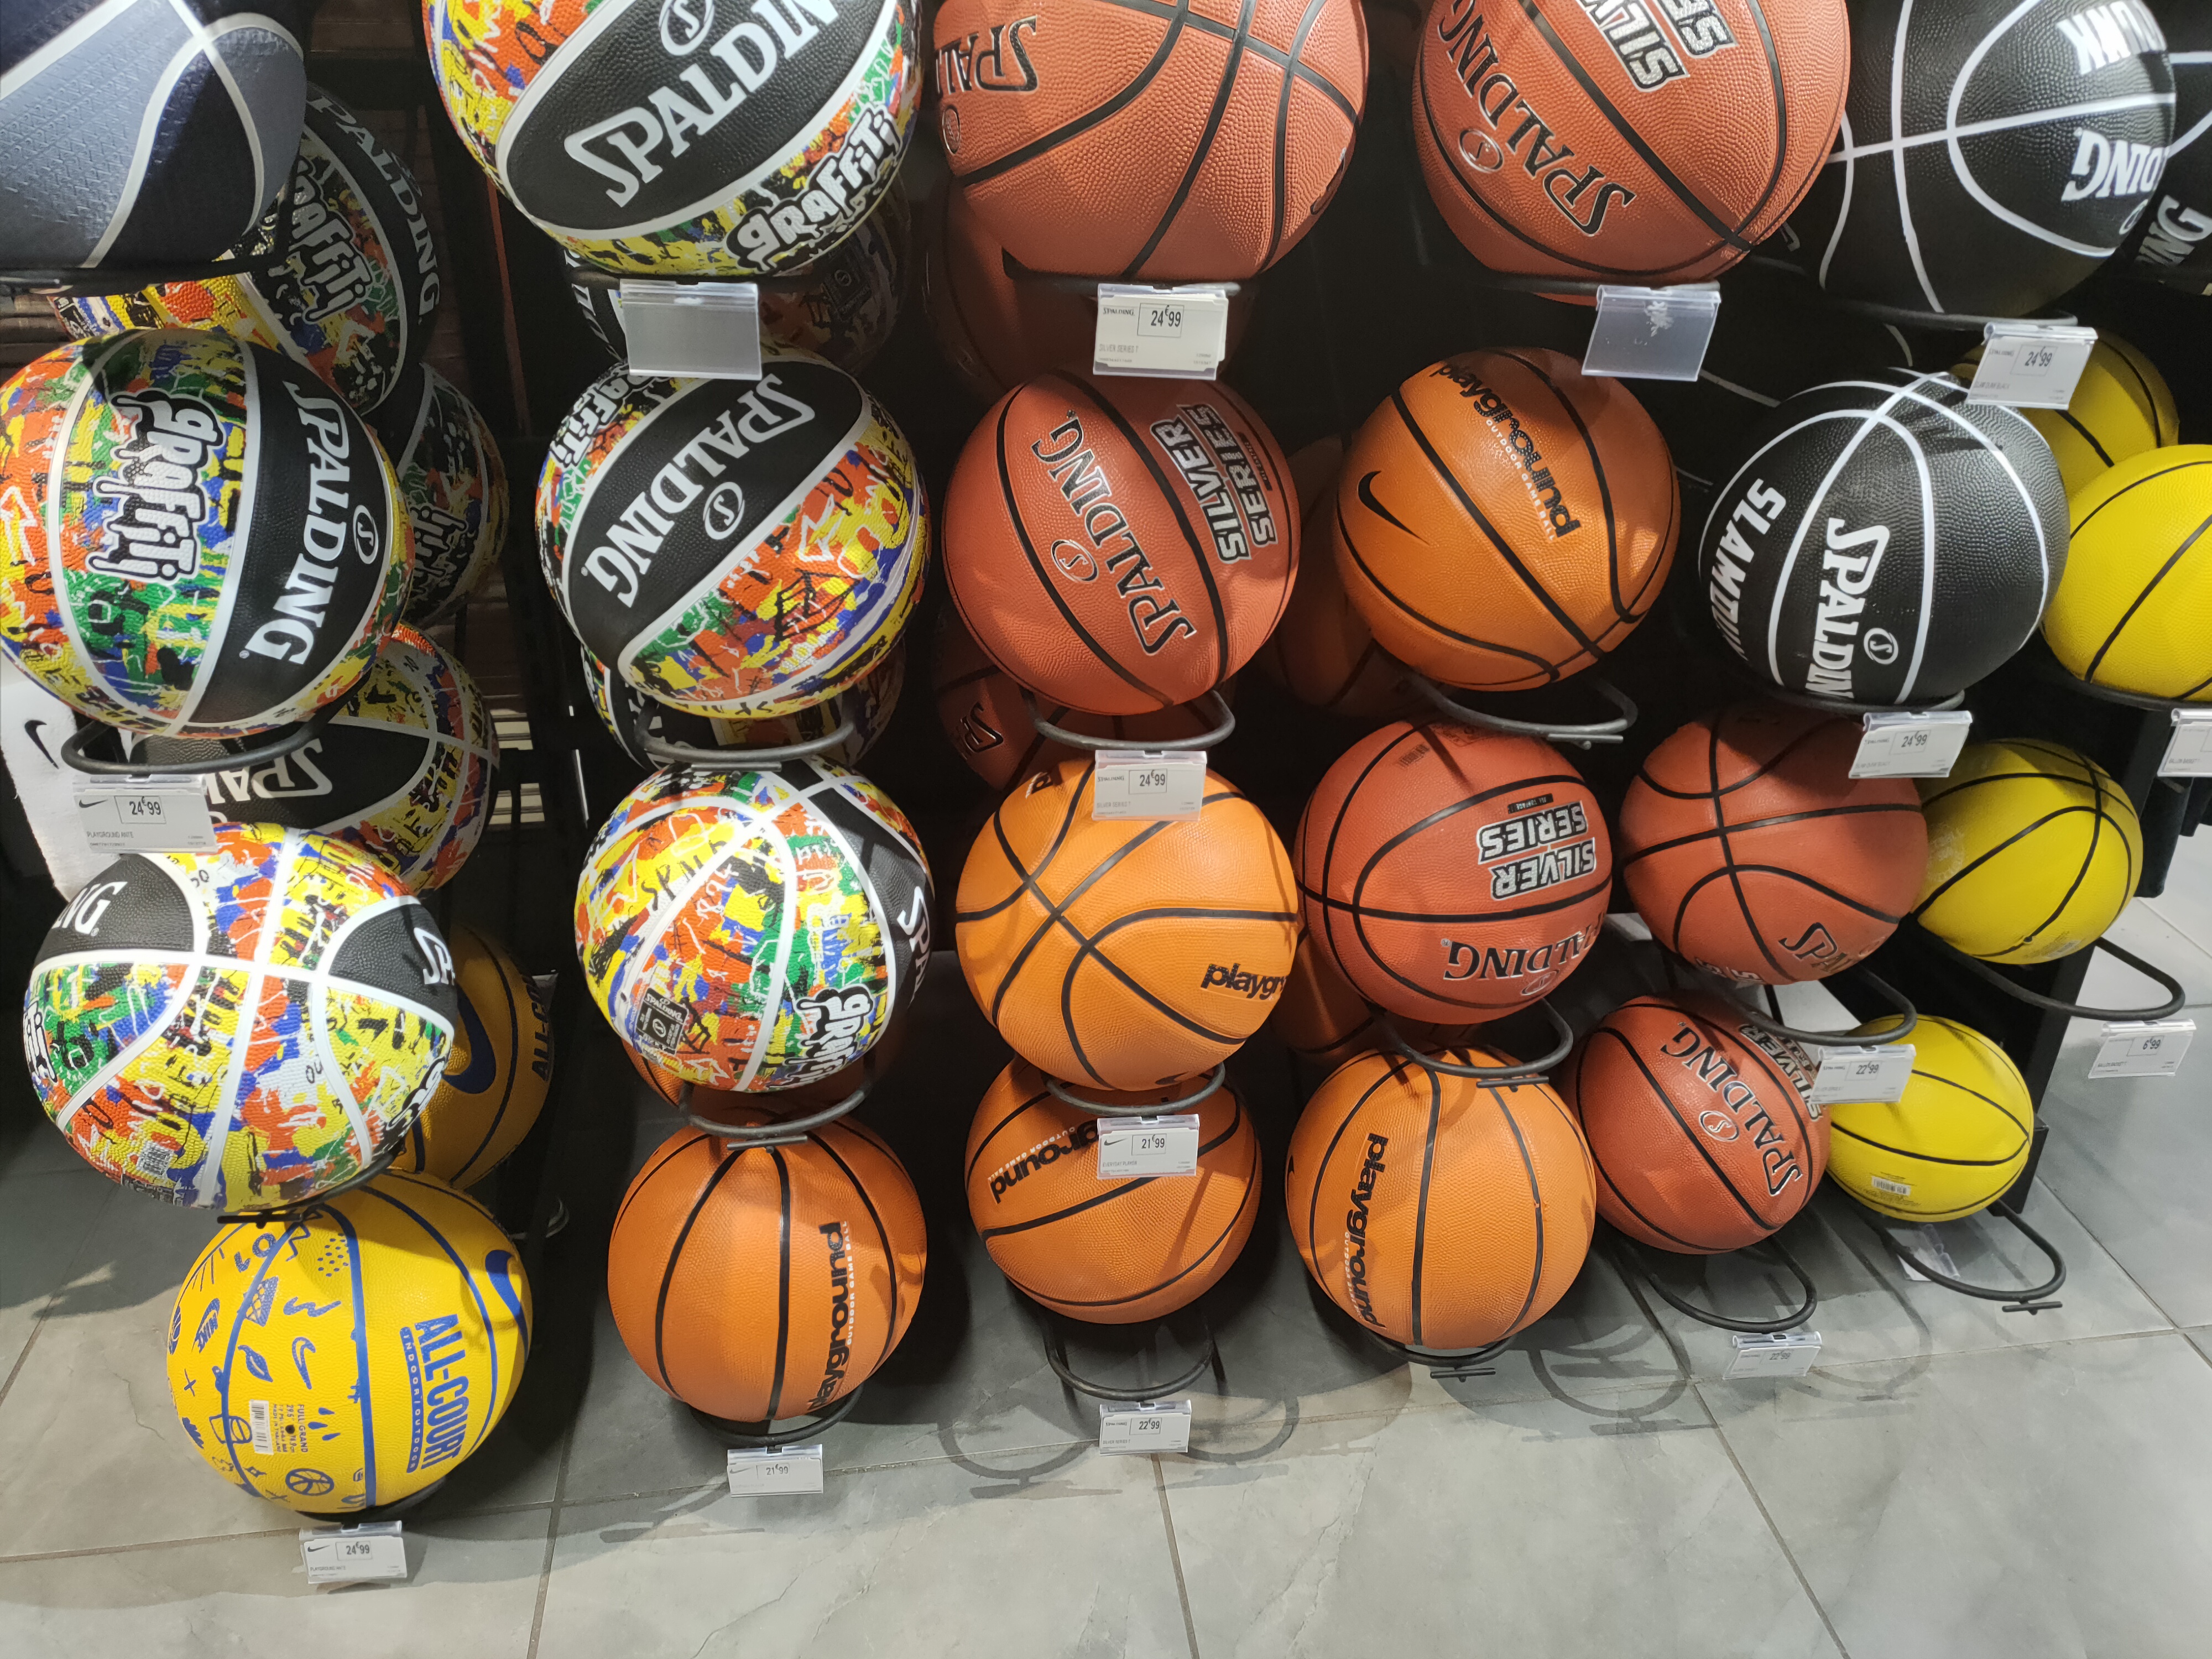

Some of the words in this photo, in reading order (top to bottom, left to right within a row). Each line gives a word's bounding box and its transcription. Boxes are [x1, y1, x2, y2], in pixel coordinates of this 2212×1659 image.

[1103, 307, 1134, 316] SPALDING
[1151, 305, 1181, 327] 24€99
[1099, 344, 1116, 352] SILVER
[1117, 345, 1134, 353] SERIES
[1429, 364, 1582, 538] playground
[1152, 418, 1250, 561] SILVER
[1183, 405, 1276, 545] SERIES
[1485, 419, 1522, 469] OUTDOOR
[1521, 472, 1541, 507] GAME
[1539, 510, 1555, 541] BALL
[585, 373, 816, 608] SPALDING
[245, 380, 350, 666] SPALDING
[1031, 416, 1197, 656] SPALDING
[1805, 518, 1890, 698] SPALDIN
[1901, 731, 1928, 748] 24€99
[1139, 769, 1166, 787] 24€99
[129, 796, 161, 815] 24€99
[1479, 803, 1589, 861] SERIES
[1491, 838, 1596, 899] SILVER
[645, 993, 683, 1022] SPALDING
[1856, 1061, 1879, 1075] 22€99
[1660, 1026, 1803, 1197] SPALDING
[1030, 1126, 1076, 1154] OUTDOOR
[1141, 1134, 1165, 1149] 21€99
[987, 1167, 1004, 1182] BALL
[990, 1120, 1098, 1204] ground
[1005, 1152, 1027, 1169] GAME
[842, 1220, 852, 1250] BALL
[414, 1314, 469, 1470] ALL-COURT
[1139, 1417, 1160, 1430] 22€99
[299, 1425, 309, 1453] GRAND
[346, 1541, 370, 1555] 24€99
